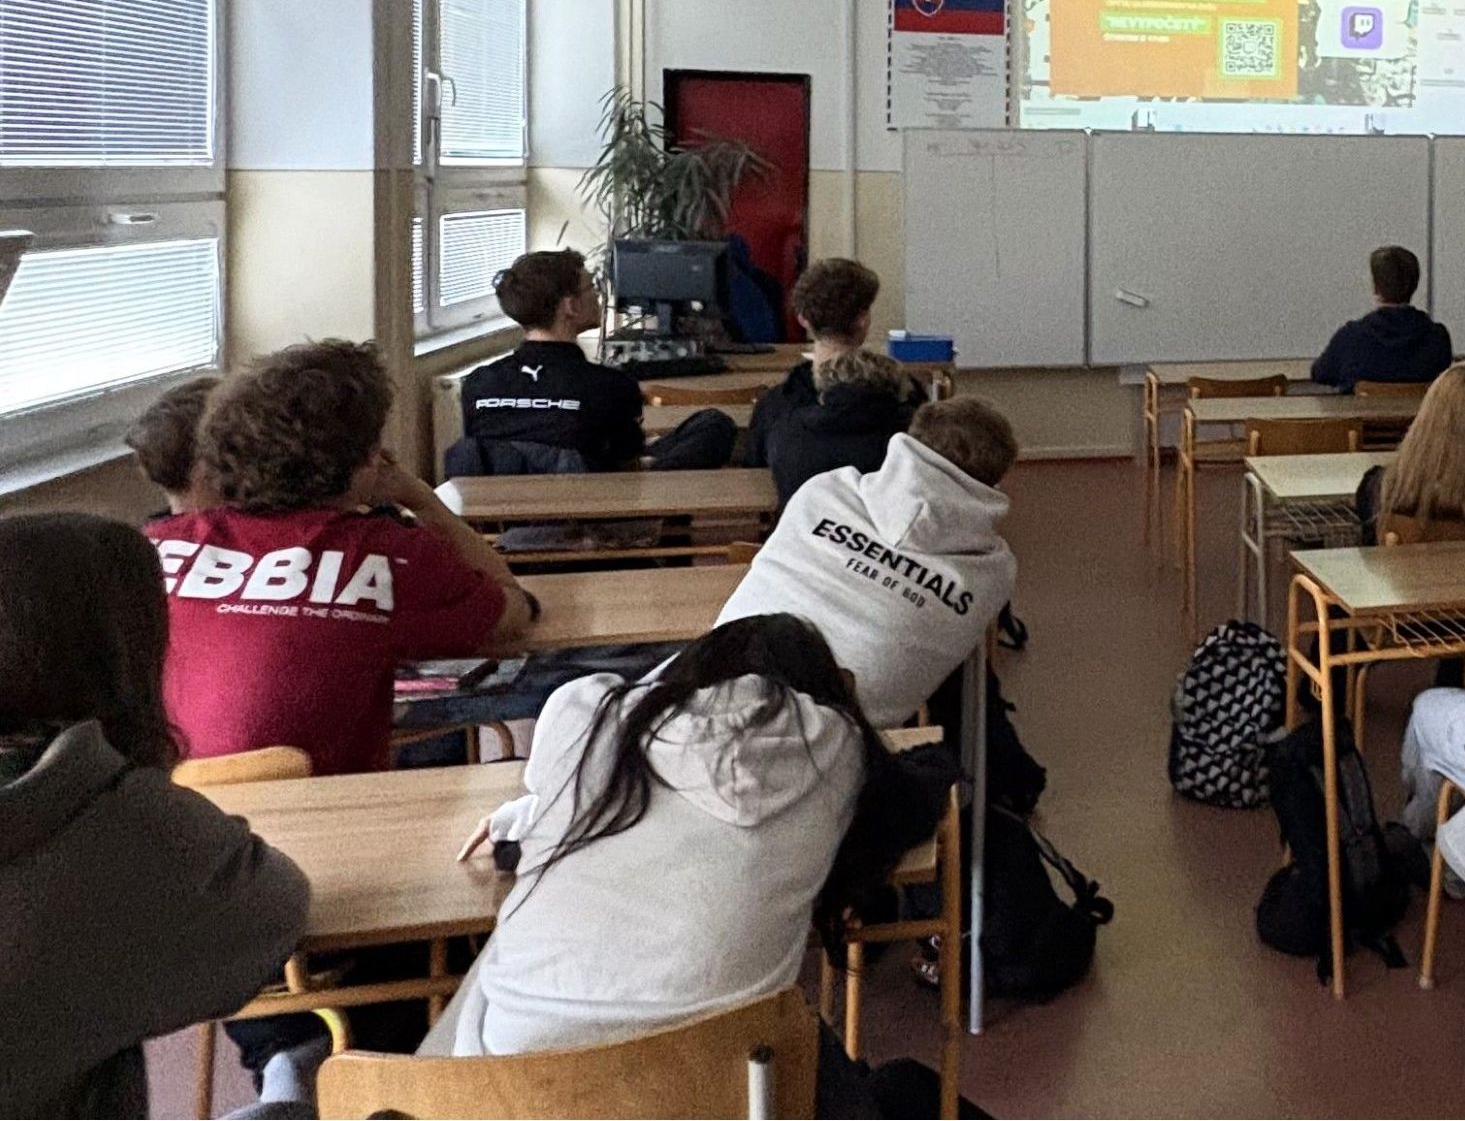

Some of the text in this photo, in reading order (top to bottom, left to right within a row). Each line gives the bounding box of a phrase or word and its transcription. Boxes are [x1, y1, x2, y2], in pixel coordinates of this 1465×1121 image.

[476, 397, 581, 411] PORSCHE
[150, 538, 394, 612] EBBIA
[812, 518, 974, 616] ESSENTIALS
[846, 557, 926, 609] FEAR OF GOD
[216, 603, 299, 617] CHALLENGE
[303, 606, 330, 619] THE
